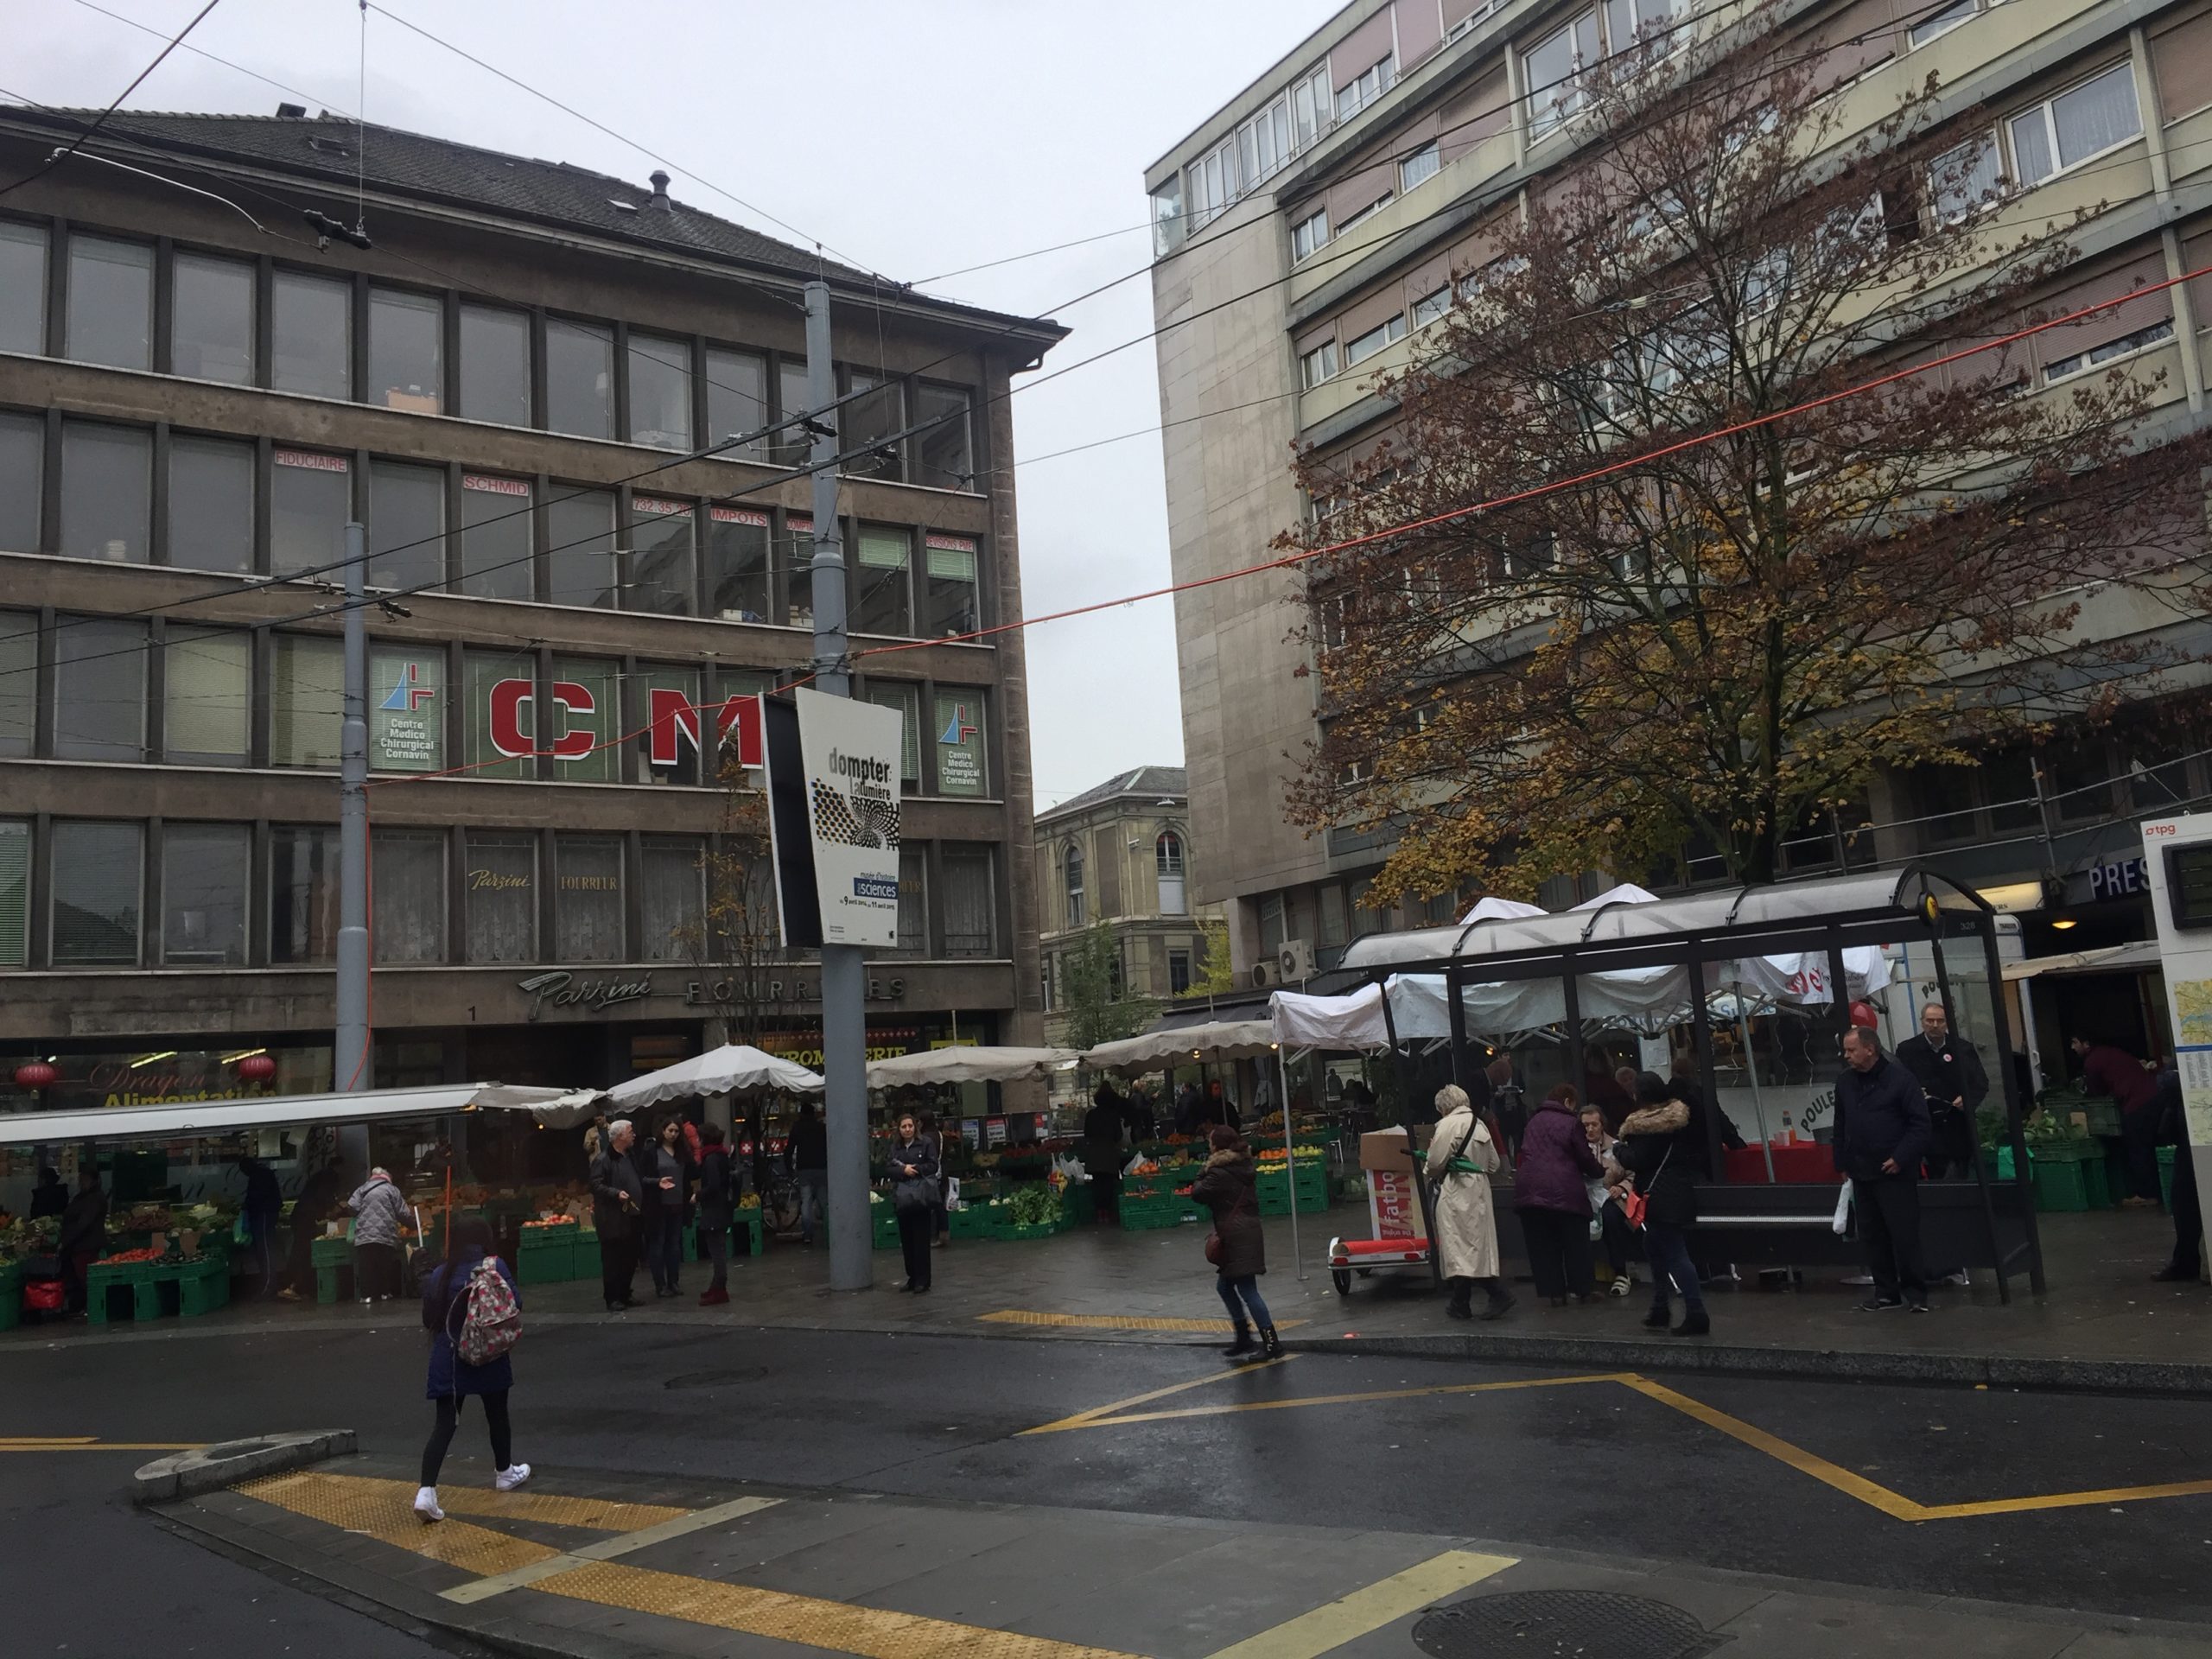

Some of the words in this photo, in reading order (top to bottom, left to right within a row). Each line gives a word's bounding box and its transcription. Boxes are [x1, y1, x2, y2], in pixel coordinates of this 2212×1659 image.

[275, 450, 346, 472] FIDUCIAIRE
[464, 476, 528, 495] SCHMID
[712, 509, 766, 525] IMPOTS
[391, 718, 423, 729] Centre
[390, 728, 425, 740] Medico
[380, 737, 434, 751] Chirurgical
[385, 748, 429, 760] Cornavin
[948, 750, 972, 760] Centre
[829, 746, 890, 784] dompter
[948, 759, 973, 768] Medico
[942, 766, 980, 778] Chirurgical
[945, 776, 976, 785] Cornavin
[2155, 824, 2176, 836] tpg
[467, 869, 531, 891] Parzini
[861, 880, 896, 898] sciences
[518, 971, 652, 1020] Parzini
